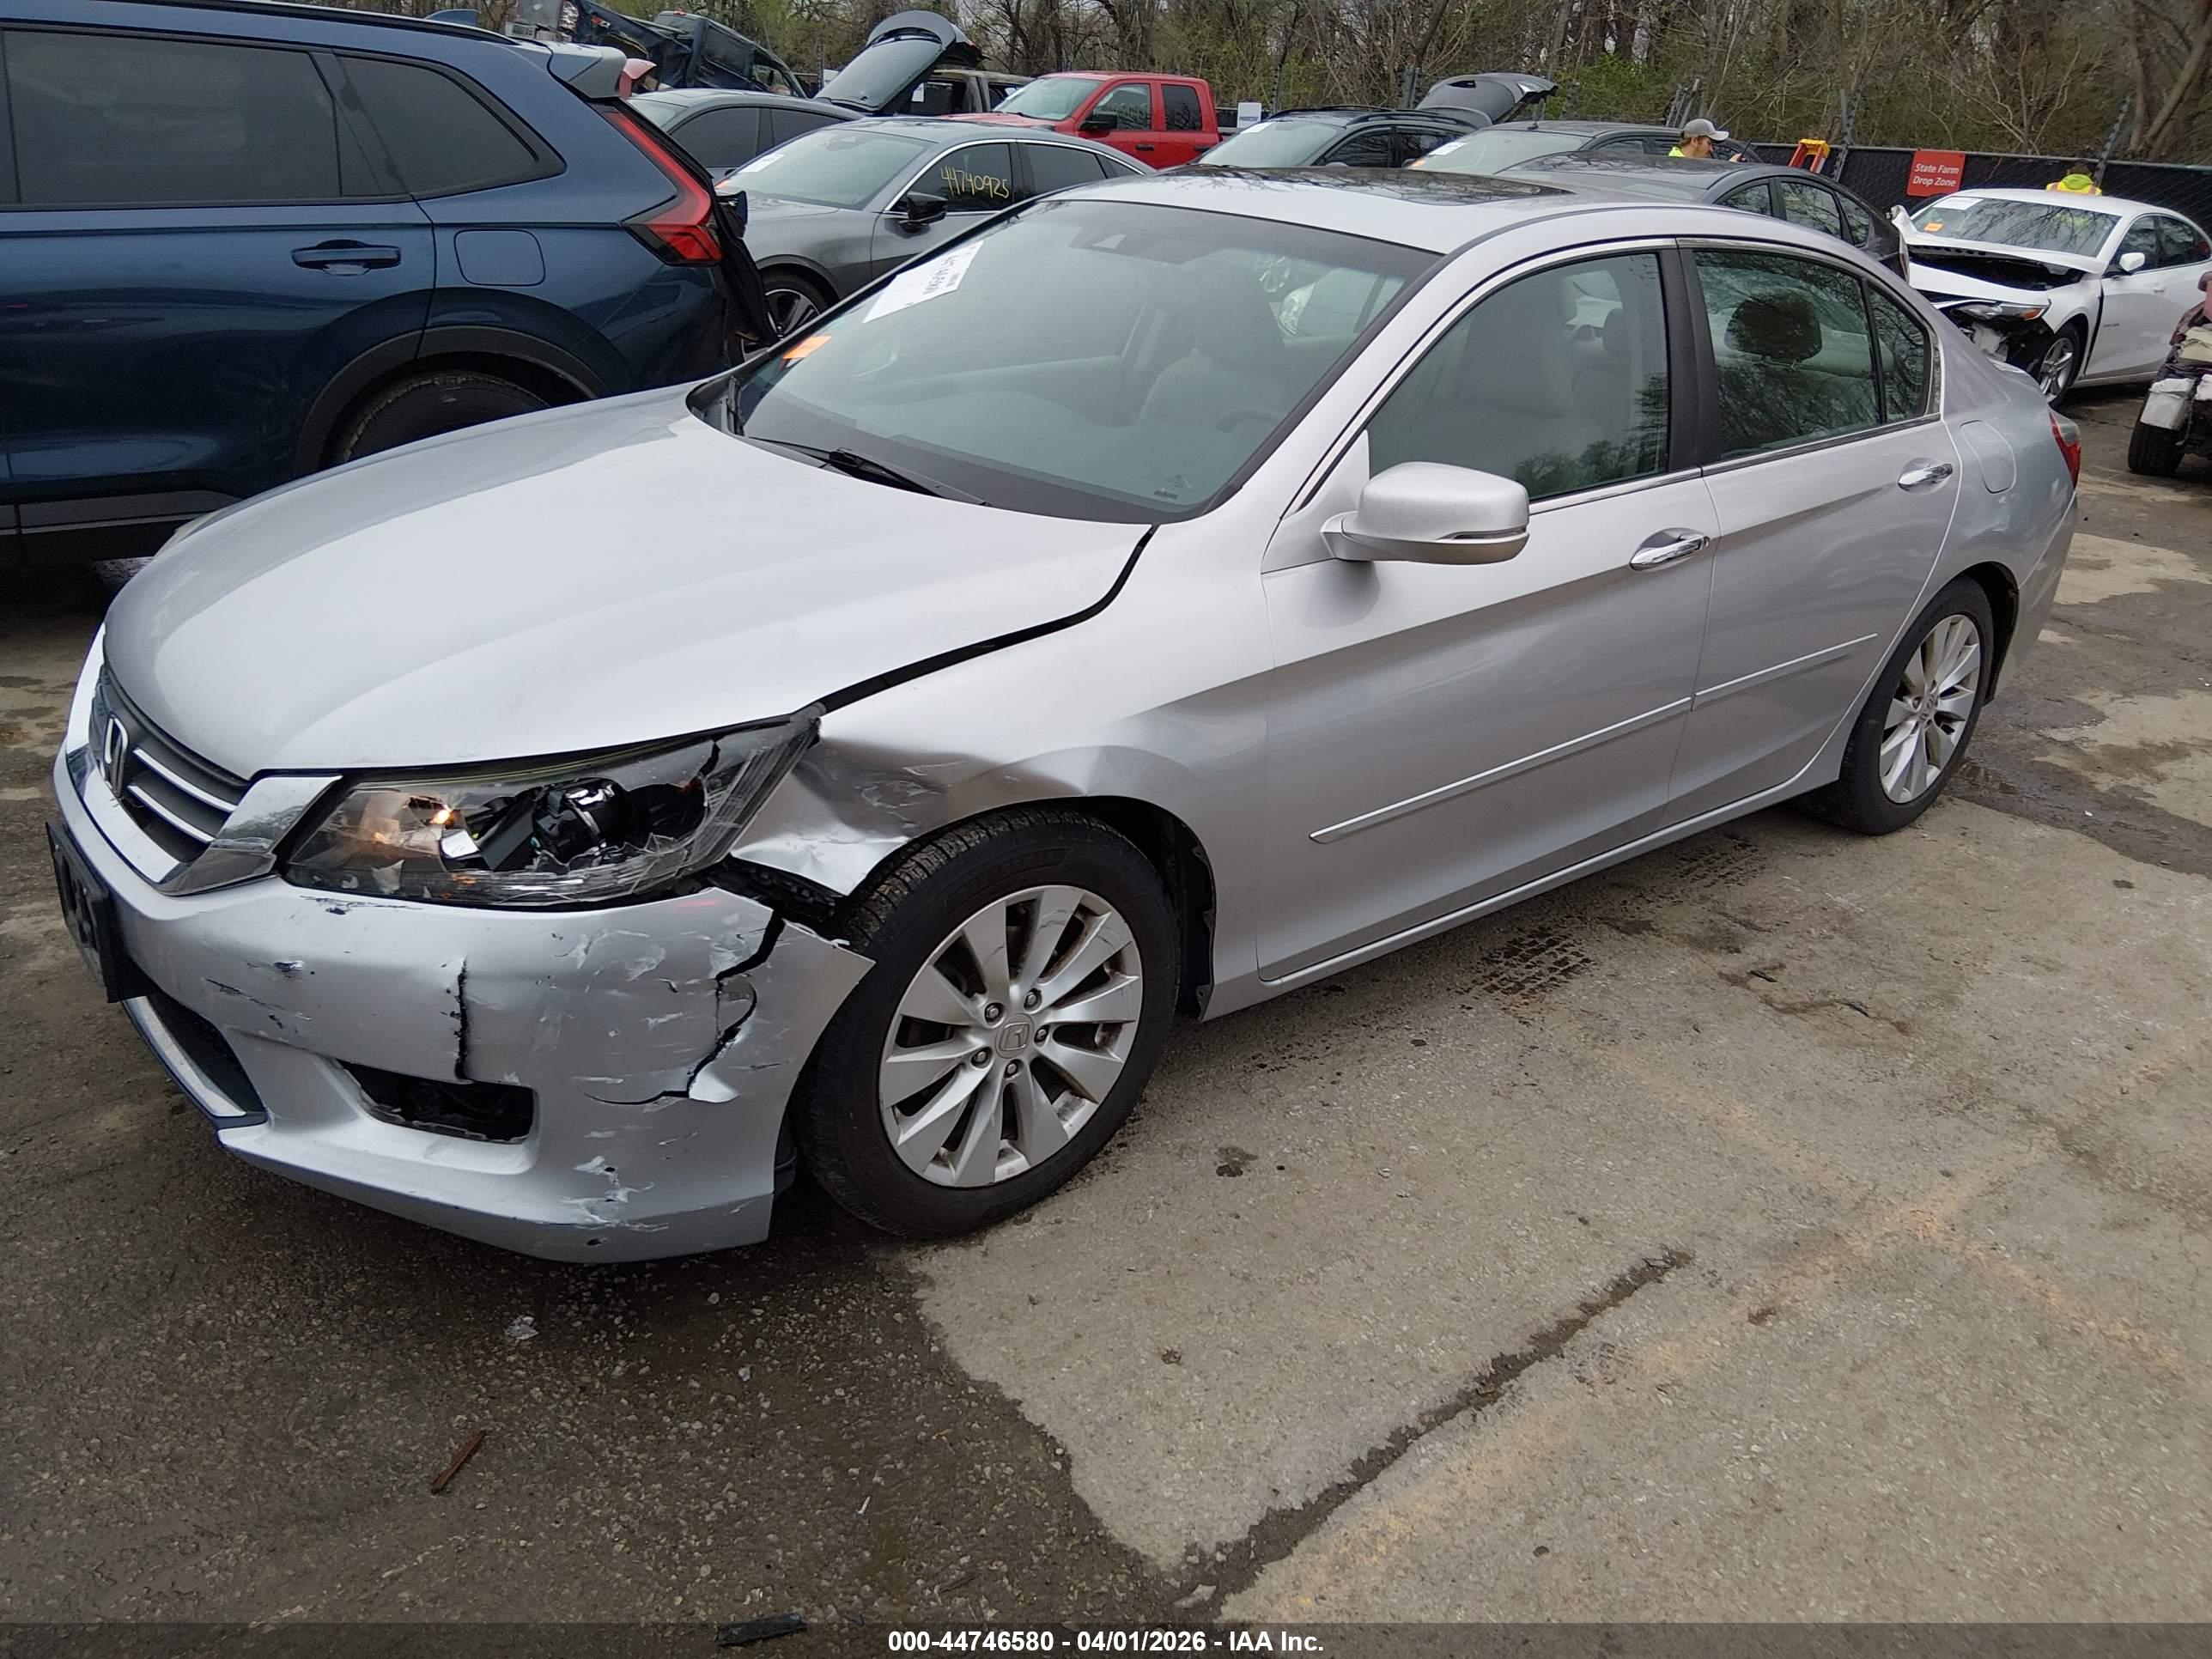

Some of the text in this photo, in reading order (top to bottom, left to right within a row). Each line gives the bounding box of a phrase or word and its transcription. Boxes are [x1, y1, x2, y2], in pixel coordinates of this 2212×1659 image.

[1914, 162, 1960, 174] State Farm
[940, 166, 1010, 198] 44740925
[1912, 175, 1957, 187] Drop Zone
